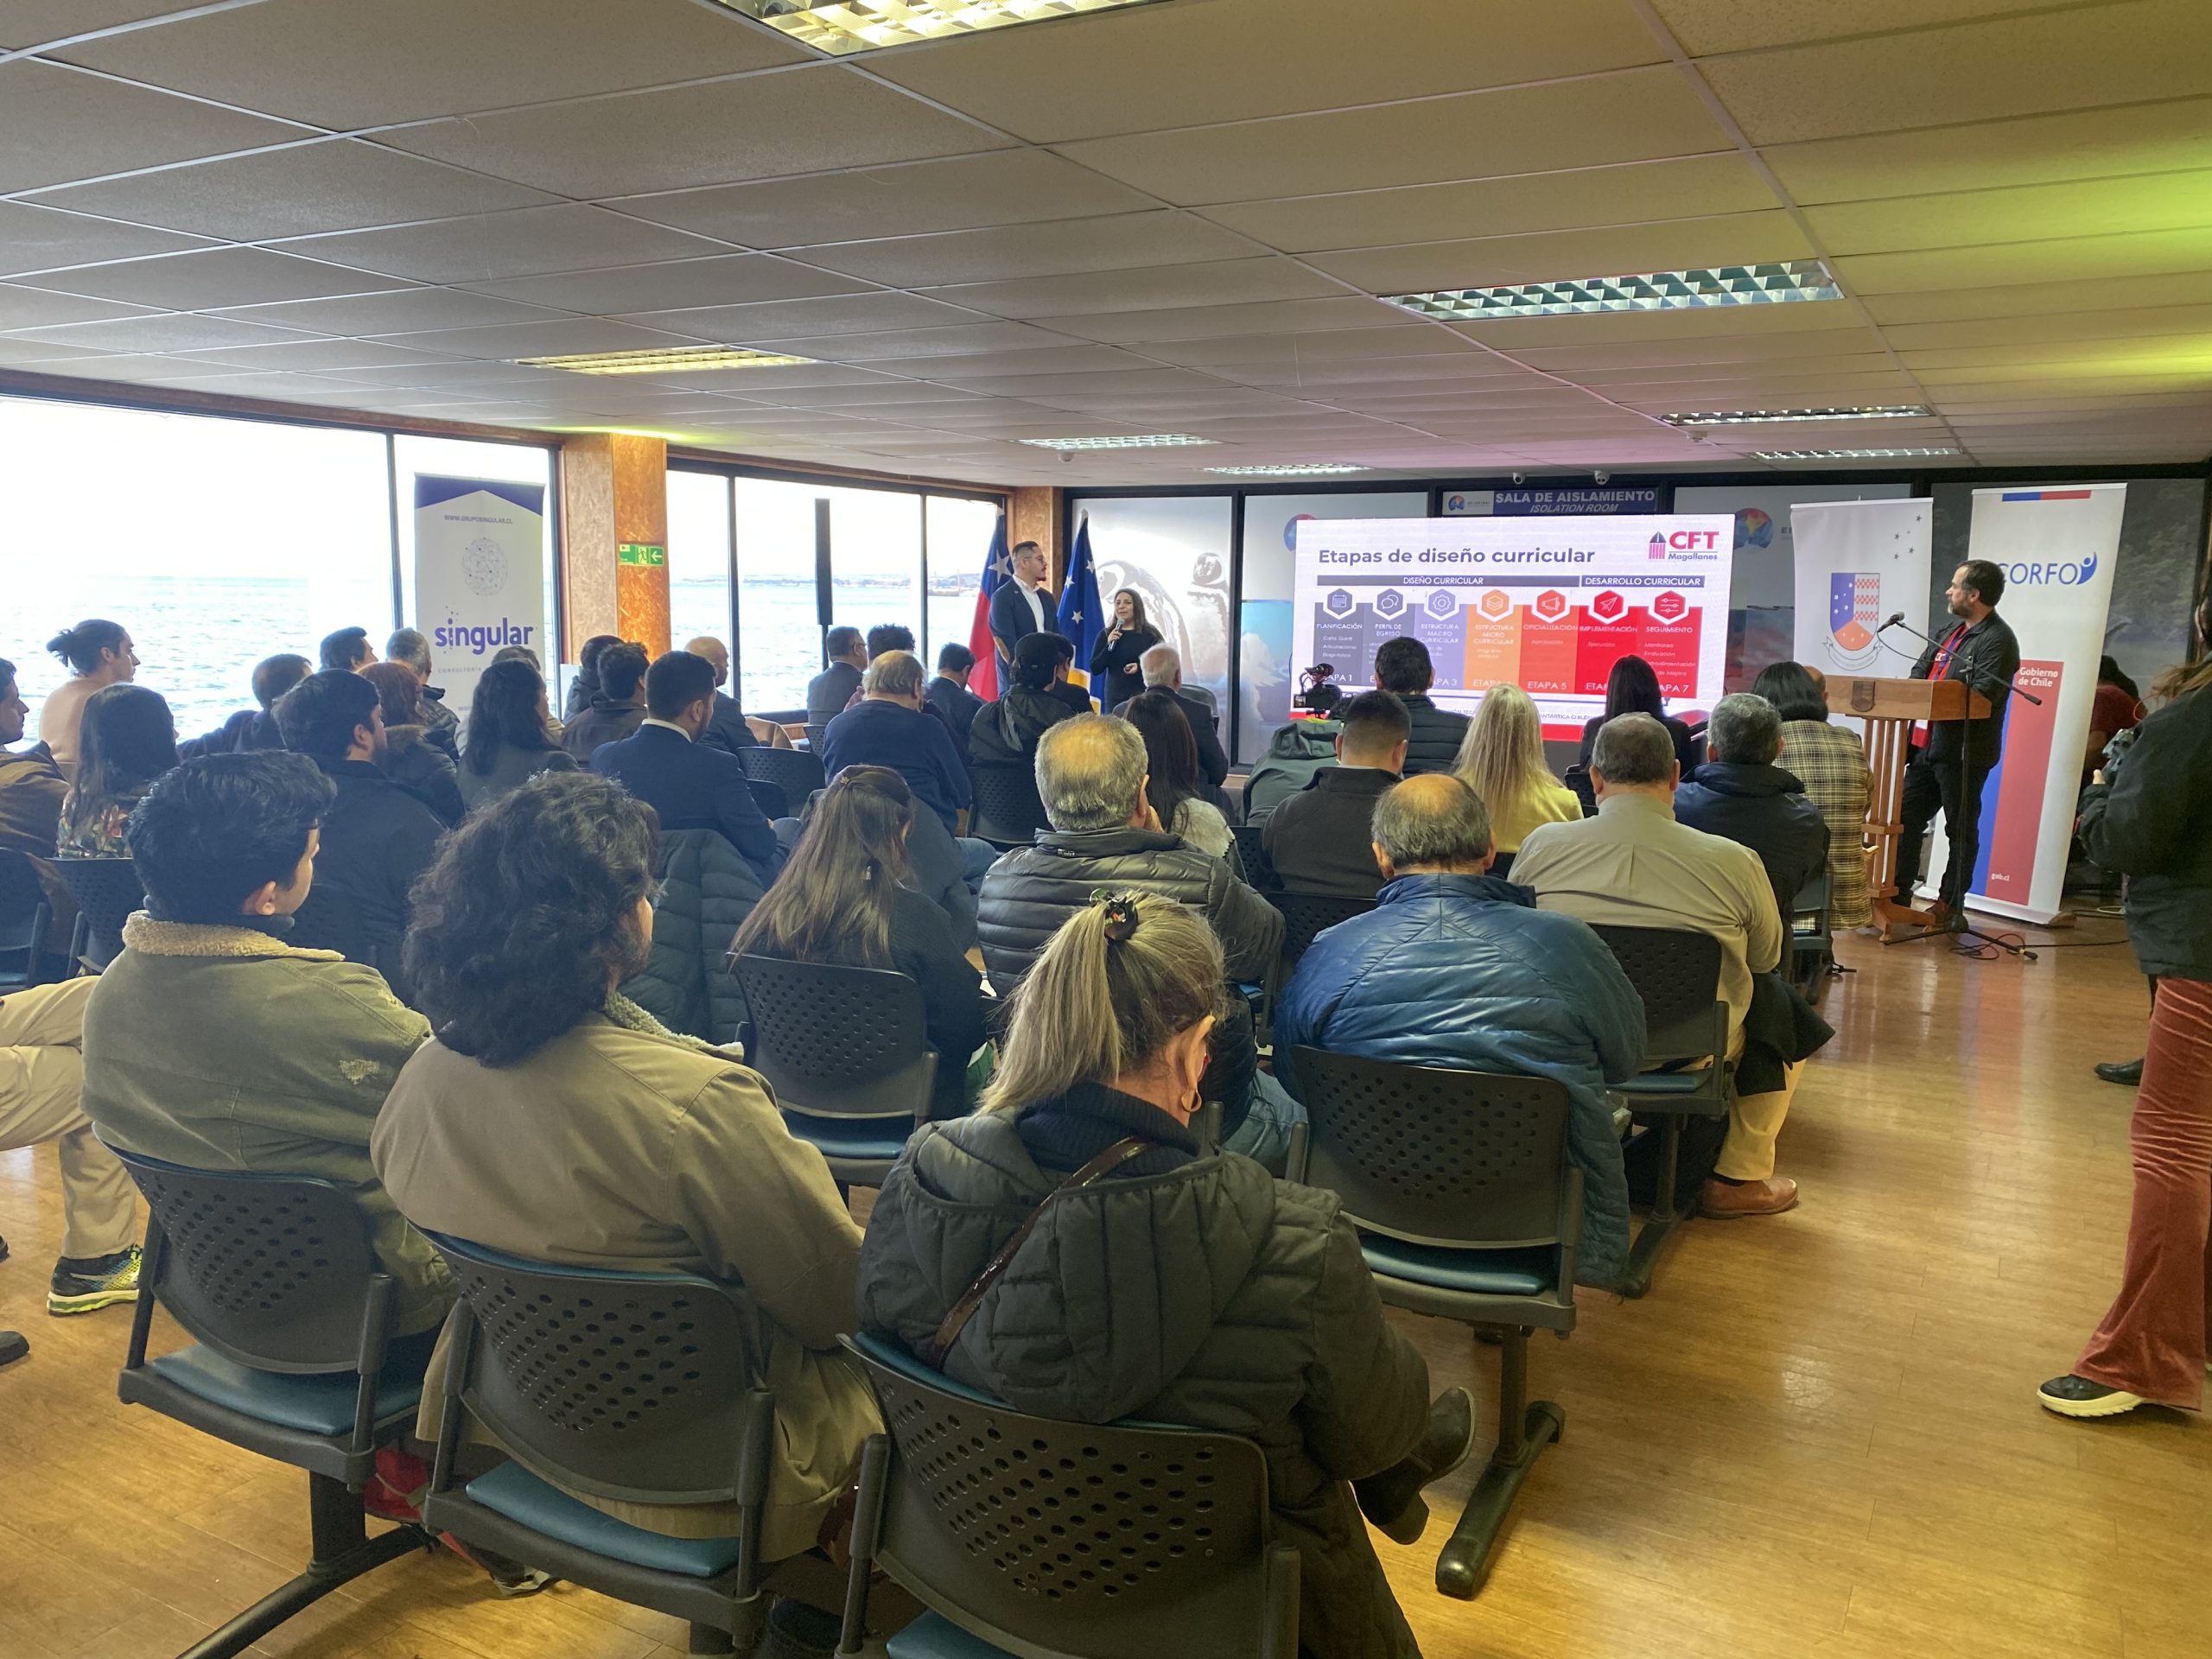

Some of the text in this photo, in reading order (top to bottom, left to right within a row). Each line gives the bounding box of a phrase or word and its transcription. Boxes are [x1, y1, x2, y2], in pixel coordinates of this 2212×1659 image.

[1496, 491, 1656, 503] SALA DE AISLAMIENTO
[1530, 504, 1618, 512] ISOLATION ROOM
[1669, 531, 1719, 550] CFT
[1319, 547, 1595, 566] Etapas de diseño curricular
[1669, 553, 1718, 562] Magallanes
[1403, 575, 1484, 585] DISEÑO CURRICULAR
[1586, 577, 1642, 586] DESARROLLO
[435, 617, 534, 655] singular
[2019, 667, 2058, 677] Gobierno
[1528, 681, 1558, 690] ETAPA
[2018, 677, 2053, 687] de Chile
